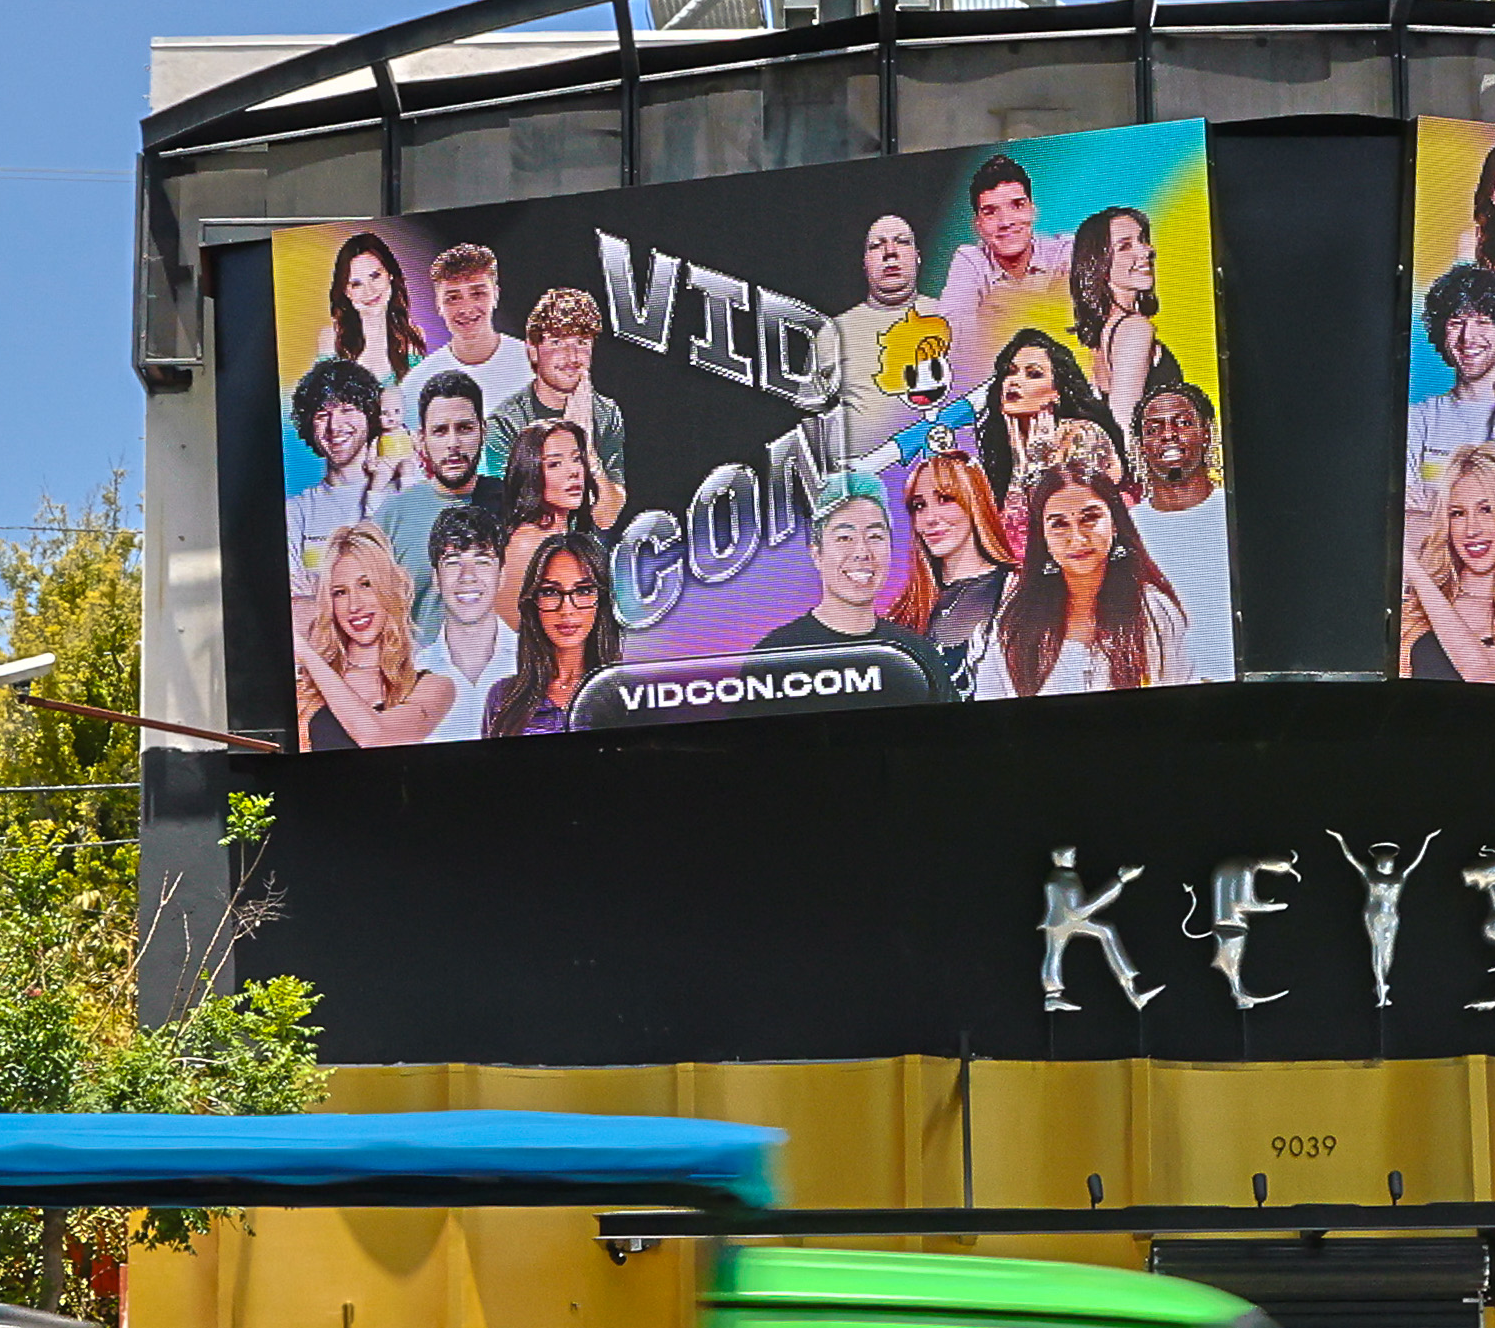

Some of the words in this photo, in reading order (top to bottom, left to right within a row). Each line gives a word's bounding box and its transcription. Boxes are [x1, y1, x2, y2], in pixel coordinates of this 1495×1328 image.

[595, 227, 844, 415] VID
[610, 411, 853, 631] CON
[618, 665, 882, 712] VIDCON.COM
[1271, 1134, 1337, 1158] 9039
